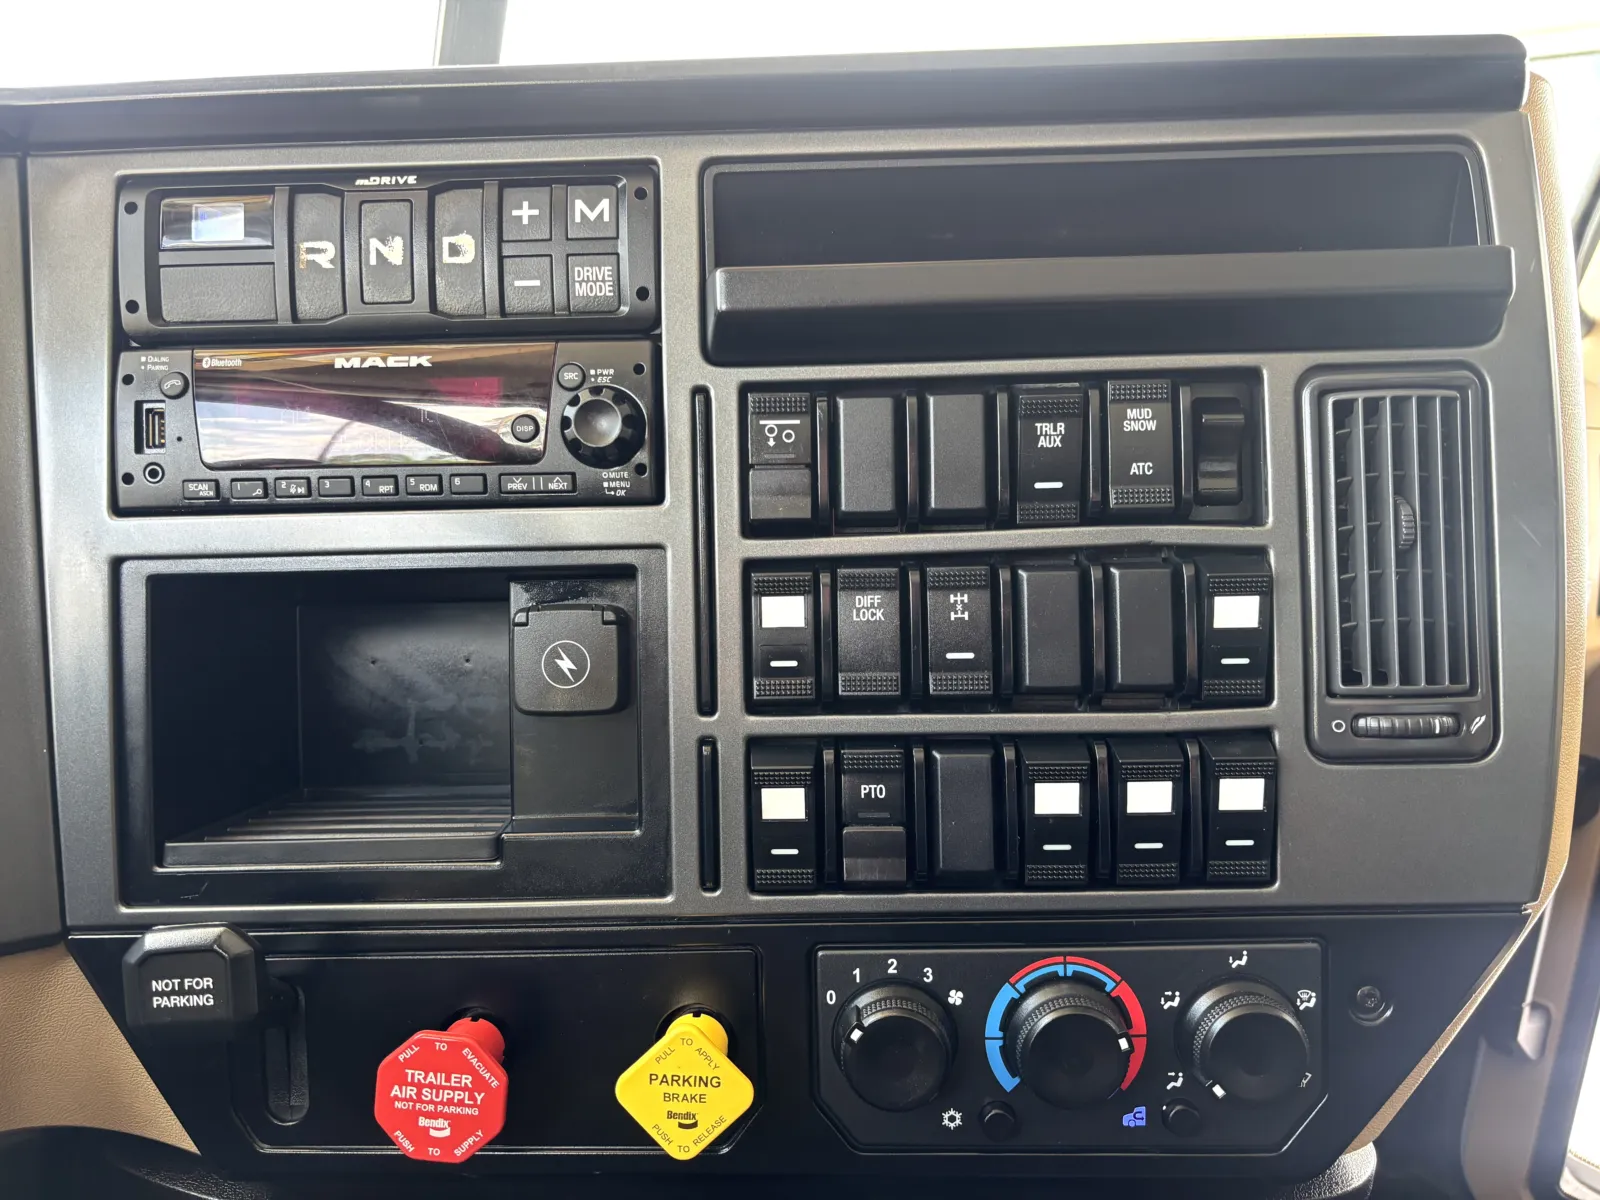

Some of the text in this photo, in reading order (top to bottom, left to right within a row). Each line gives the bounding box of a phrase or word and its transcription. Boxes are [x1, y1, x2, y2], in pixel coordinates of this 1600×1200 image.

[575, 198, 609, 222] M
[299, 241, 336, 268] R
[369, 236, 404, 266] N
[442, 231, 475, 264] D
[575, 266, 612, 281] DRIVE
[575, 282, 614, 296] MODE
[211, 358, 242, 366] Bluetooth
[334, 356, 432, 368] MACK
[564, 372, 578, 380] SRC
[1126, 408, 1152, 420] MUD
[1035, 423, 1065, 435] TRLR
[1123, 420, 1156, 431] SNOW
[1038, 436, 1062, 448] AUX
[1130, 462, 1153, 475] ATC
[410, 478, 415, 486] 5
[508, 482, 527, 490] PREV
[548, 482, 568, 490] NEXT
[855, 595, 882, 608] DIFF
[853, 608, 885, 621] LOCK
[860, 784, 886, 798] PTO
[888, 958, 898, 974] 2
[852, 968, 860, 983] 1
[923, 968, 933, 982] 3
[152, 977, 214, 992] NOT FOR
[152, 994, 214, 1008] PARKING
[826, 990, 836, 1004] 0
[654, 1038, 720, 1071] PULL TO APPLY
[398, 1042, 500, 1088] PULL TO EVACUATE
[405, 1068, 472, 1088] TRAILER
[649, 1073, 721, 1088] PARKING
[390, 1084, 485, 1105] AIR SUPPLY
[663, 1092, 707, 1104] BRAKE
[394, 1101, 479, 1116] NOT FOR PARKING
[666, 1110, 696, 1120] Bendix
[418, 1116, 449, 1128] Bendix
[652, 1115, 727, 1153] PUSH TO RELEASE
[394, 1130, 484, 1156] PUSH TO SUPPLY
